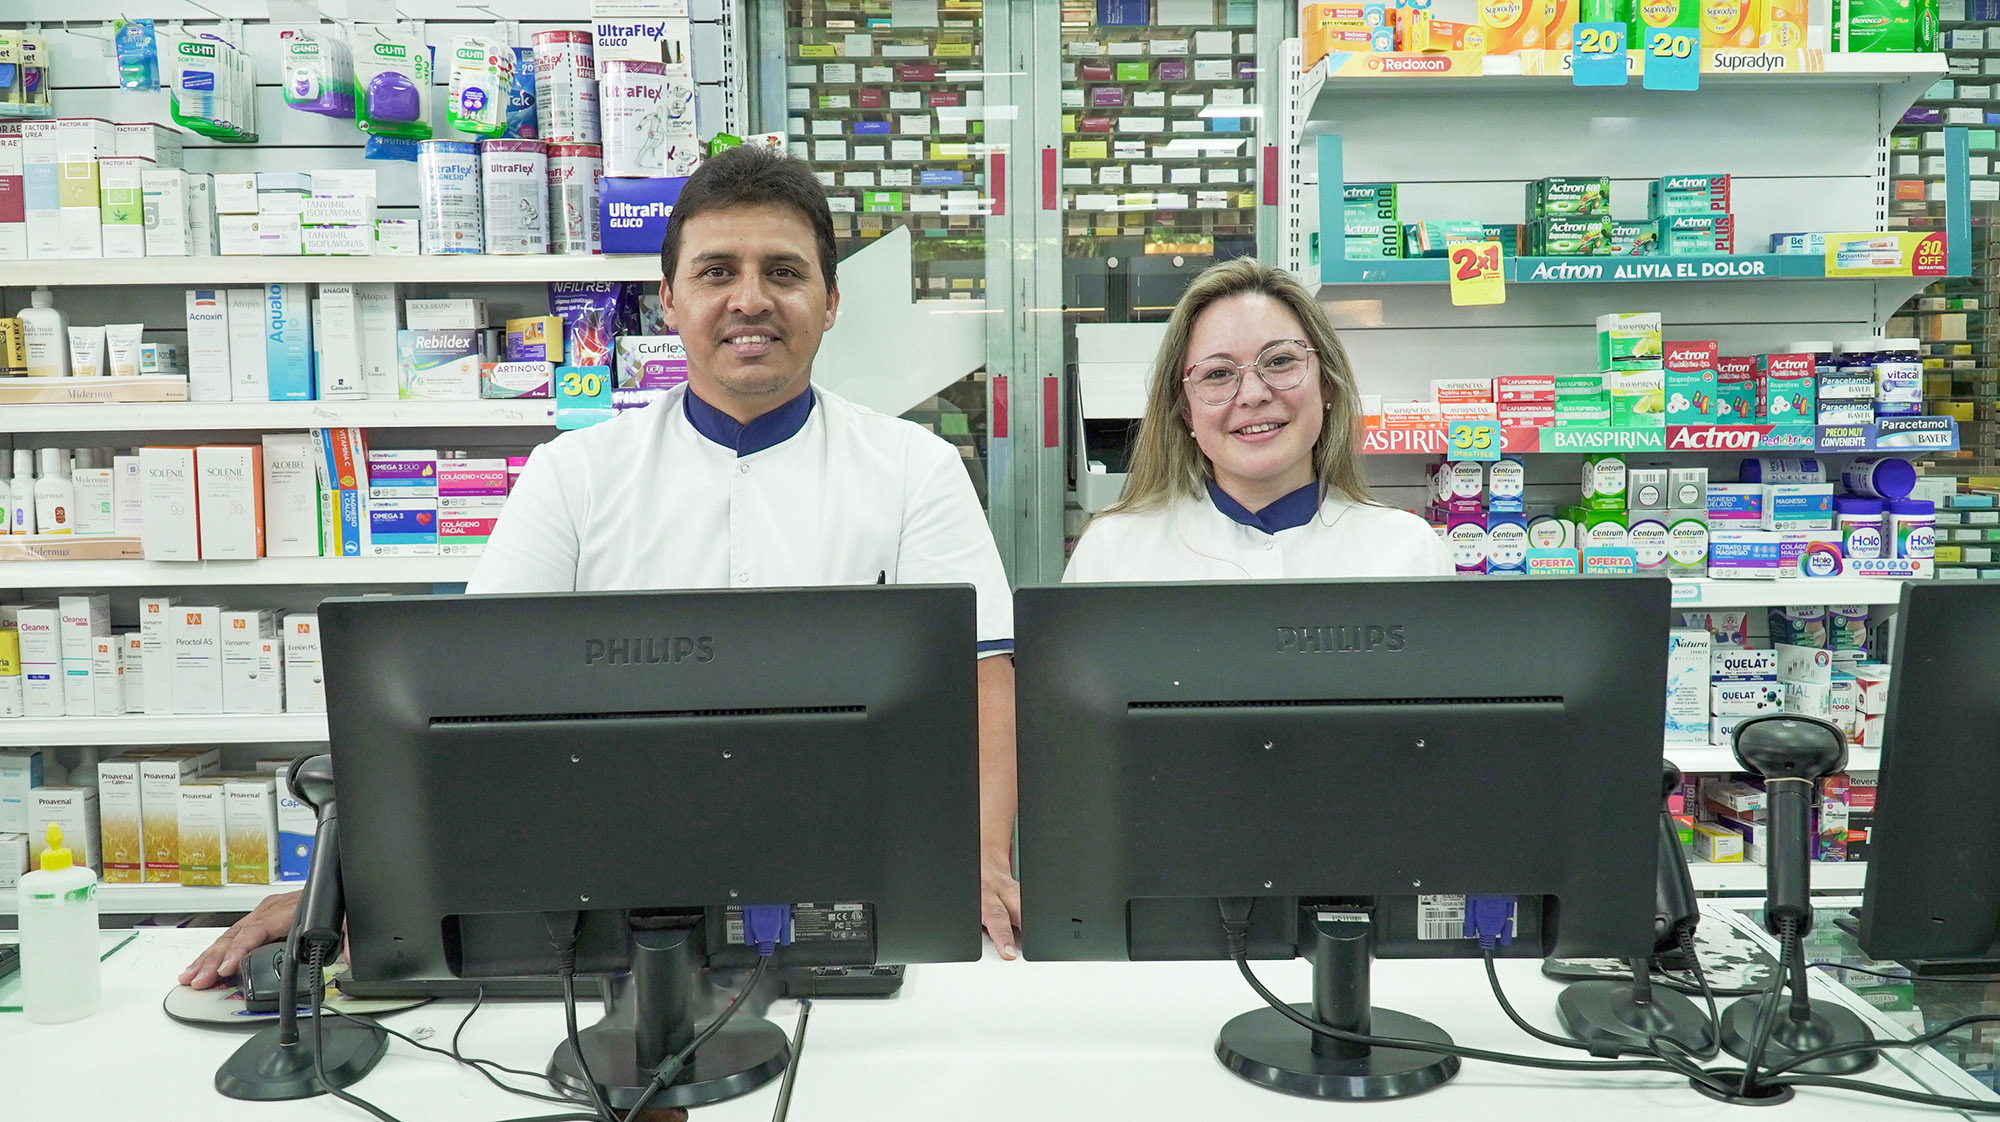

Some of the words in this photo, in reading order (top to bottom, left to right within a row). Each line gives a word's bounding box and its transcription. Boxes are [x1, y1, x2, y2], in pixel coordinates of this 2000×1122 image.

[1484, 4, 1520, 15] Supradyn
[1643, 4, 1677, 14] Supradyn
[1706, 7, 1738, 16] Supradyn
[1851, 17, 1883, 25] Berocca
[597, 22, 665, 41] UltraFlex
[599, 38, 628, 47] GLUCO
[1385, 58, 1444, 71] Redoxon
[1713, 52, 1785, 71] Supradyn
[10, 124, 21, 134] AE
[24, 124, 49, 133] FACTOR
[59, 121, 81, 129] FACTOR
[25, 132, 43, 141] UREA
[103, 160, 123, 168] FACTOR
[491, 163, 534, 177] UltraFlex
[1668, 177, 1708, 188] Actron
[1549, 183, 1585, 193] Actron
[1586, 183, 1600, 193] 600
[1711, 177, 1726, 211] PLUS
[306, 200, 346, 209] TANVIMIL
[1377, 188, 1392, 220] 600
[306, 208, 362, 218] ISOFLAVONAS
[609, 202, 675, 218] UltraFle
[610, 217, 643, 228] GLUCO
[1551, 222, 1586, 232] Actron
[1587, 222, 1602, 232] 600
[1673, 217, 1713, 228] Actron
[308, 231, 347, 240] TANVIMIL
[1612, 225, 1640, 236] ctron
[1715, 217, 1730, 251] PLUS
[308, 240, 365, 248] ISOFLAVONAS
[1382, 225, 1398, 257] 600
[1837, 252, 1871, 261] Bepanthol
[1919, 256, 1942, 266] OFF
[1530, 262, 1603, 280] Actron
[1614, 264, 1672, 279] ALIVIA
[1677, 263, 1698, 277] EL
[1701, 261, 1765, 278] DOLOR
[322, 287, 350, 295] ANAGEN
[361, 290, 389, 303] Atopix
[232, 299, 261, 311] Atopix
[189, 313, 223, 321] Acnoxin
[268, 284, 286, 343] Aqualo
[415, 335, 471, 352] Rebildex
[1668, 350, 1710, 361] Actron
[497, 364, 546, 374] ARTINOVO
[1771, 359, 1808, 370] Actron
[1668, 376, 1700, 384] Ibuprofeno
[1887, 370, 1919, 380] vitacal
[1447, 382, 1484, 390] ASPIRINETAS
[1620, 381, 1657, 389] BAYASPIRINA
[1821, 377, 1872, 385] Paracetamol
[67, 389, 113, 399] Midermus
[1393, 407, 1431, 415] ASPIRINETAS
[1449, 407, 1488, 415] ASPIRINETAS
[1506, 405, 1542, 413] CAFIASPIRINA
[1821, 403, 1871, 412] Paracetamol
[1847, 412, 1871, 420] BAYER
[1881, 419, 1948, 431] Paracetamol
[1669, 426, 1760, 449] Actron
[1761, 434, 1813, 448] Pediátrico
[1825, 427, 1848, 438] PRECIO
[1848, 427, 1864, 438] MUY
[339, 429, 350, 460] VITAMINA
[1554, 431, 1662, 449] BAYASPIRINA
[1821, 436, 1866, 448] CONVENIENTE
[1917, 434, 1949, 445] BAYER
[271, 460, 305, 470] ALOEBEL
[371, 463, 398, 471] OMEGA
[398, 463, 404, 471] 3
[1493, 466, 1521, 474] Centrum
[1597, 465, 1624, 473] Centrum
[149, 469, 184, 479] SOLENIL
[207, 467, 244, 479] SOLENIL
[1454, 467, 1481, 475] Centrum
[440, 472, 476, 481] COLÁGENO
[372, 512, 398, 520] OMEGA
[398, 512, 404, 520] 3
[441, 520, 480, 529] COLÁGENO
[1452, 531, 1483, 539] Centrum
[1593, 529, 1624, 538] Centrum
[1632, 529, 1665, 538] Centrum
[1672, 528, 1704, 537] Centrum
[1852, 535, 1879, 547] Holo
[1911, 534, 1935, 546] Holo
[1531, 558, 1574, 568] OFERTA
[1588, 557, 1632, 567] OFERTA
[1812, 556, 1832, 564] Holo
[1842, 608, 1858, 616] MAX
[3, 620, 18, 628] Clea
[21, 624, 50, 632] Cleanex
[176, 638, 202, 646] Piroctol
[1276, 624, 1407, 654] PHILIPS
[1672, 638, 1708, 649] Natura
[585, 635, 715, 667] PHILIPS
[1724, 659, 1768, 670] QUELAT
[1722, 691, 1755, 700] QUELAT
[102, 773, 133, 781] Proavenal
[144, 773, 176, 781] Proavenal
[1850, 777, 1878, 786] Revers
[182, 792, 213, 800] Proavenal
[39, 798, 72, 806] Proavenal
